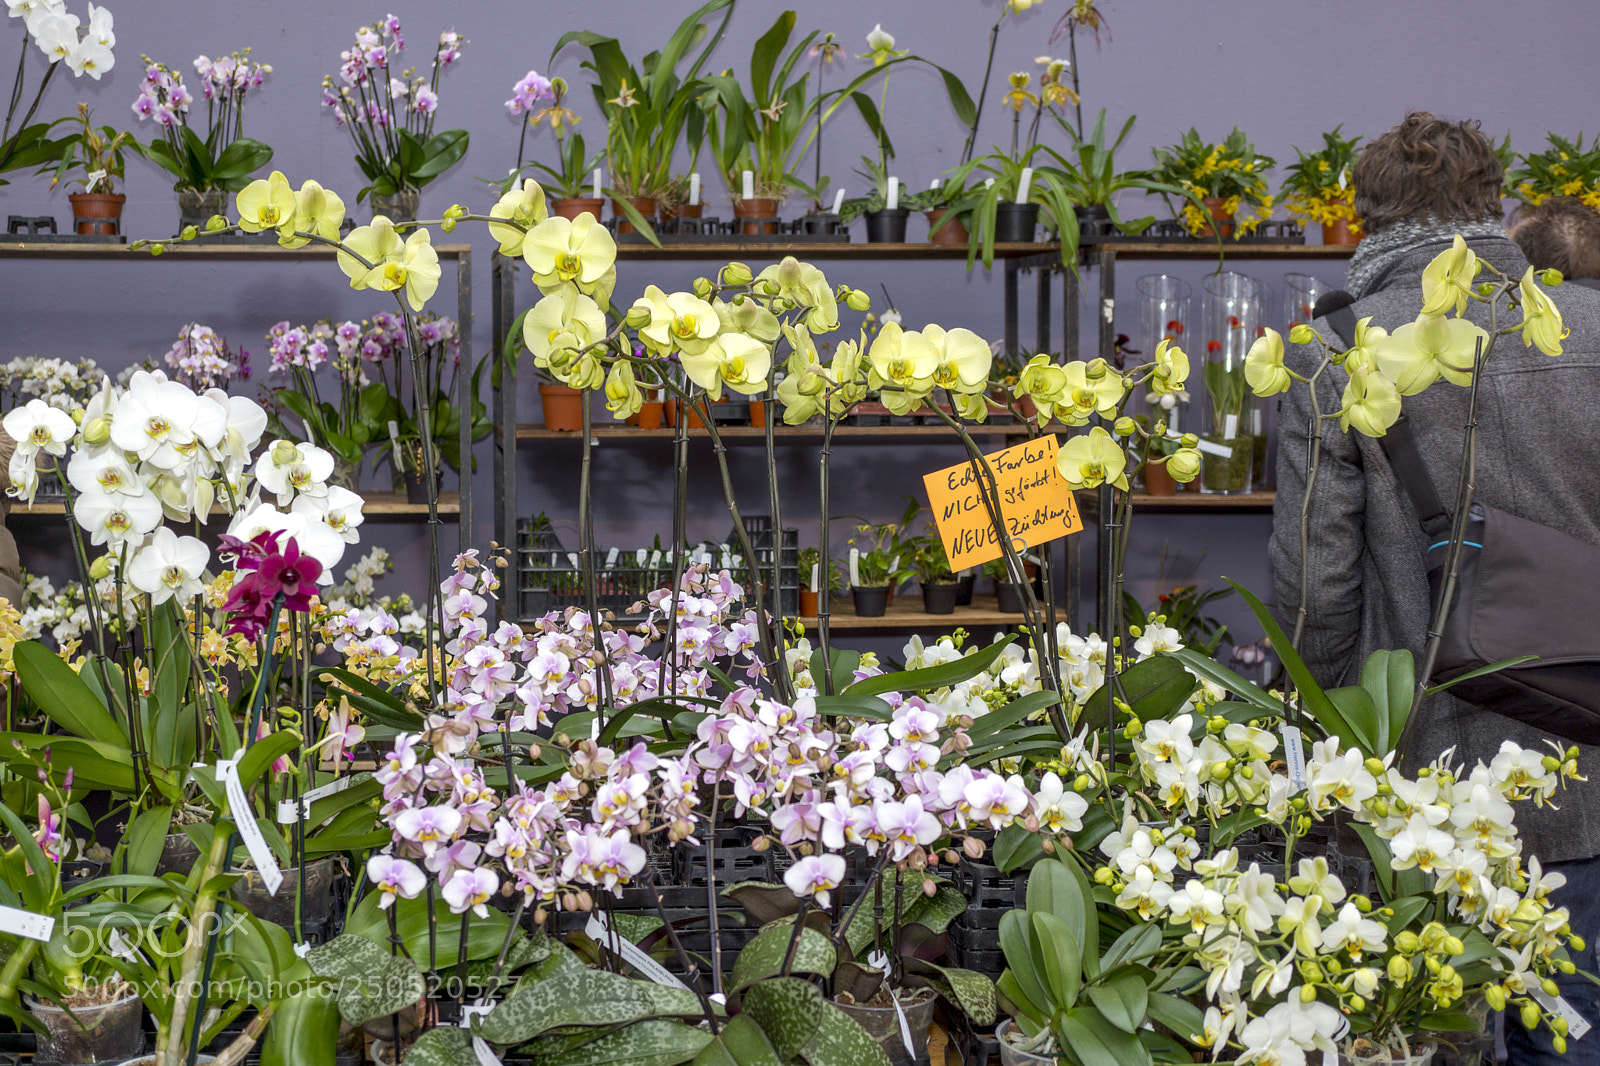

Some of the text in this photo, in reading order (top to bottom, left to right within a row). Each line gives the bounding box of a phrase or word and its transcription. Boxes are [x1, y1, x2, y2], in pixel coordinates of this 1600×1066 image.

[991, 439, 1054, 474] Farbe!
[951, 496, 1076, 559] NEUE Züchtung!
